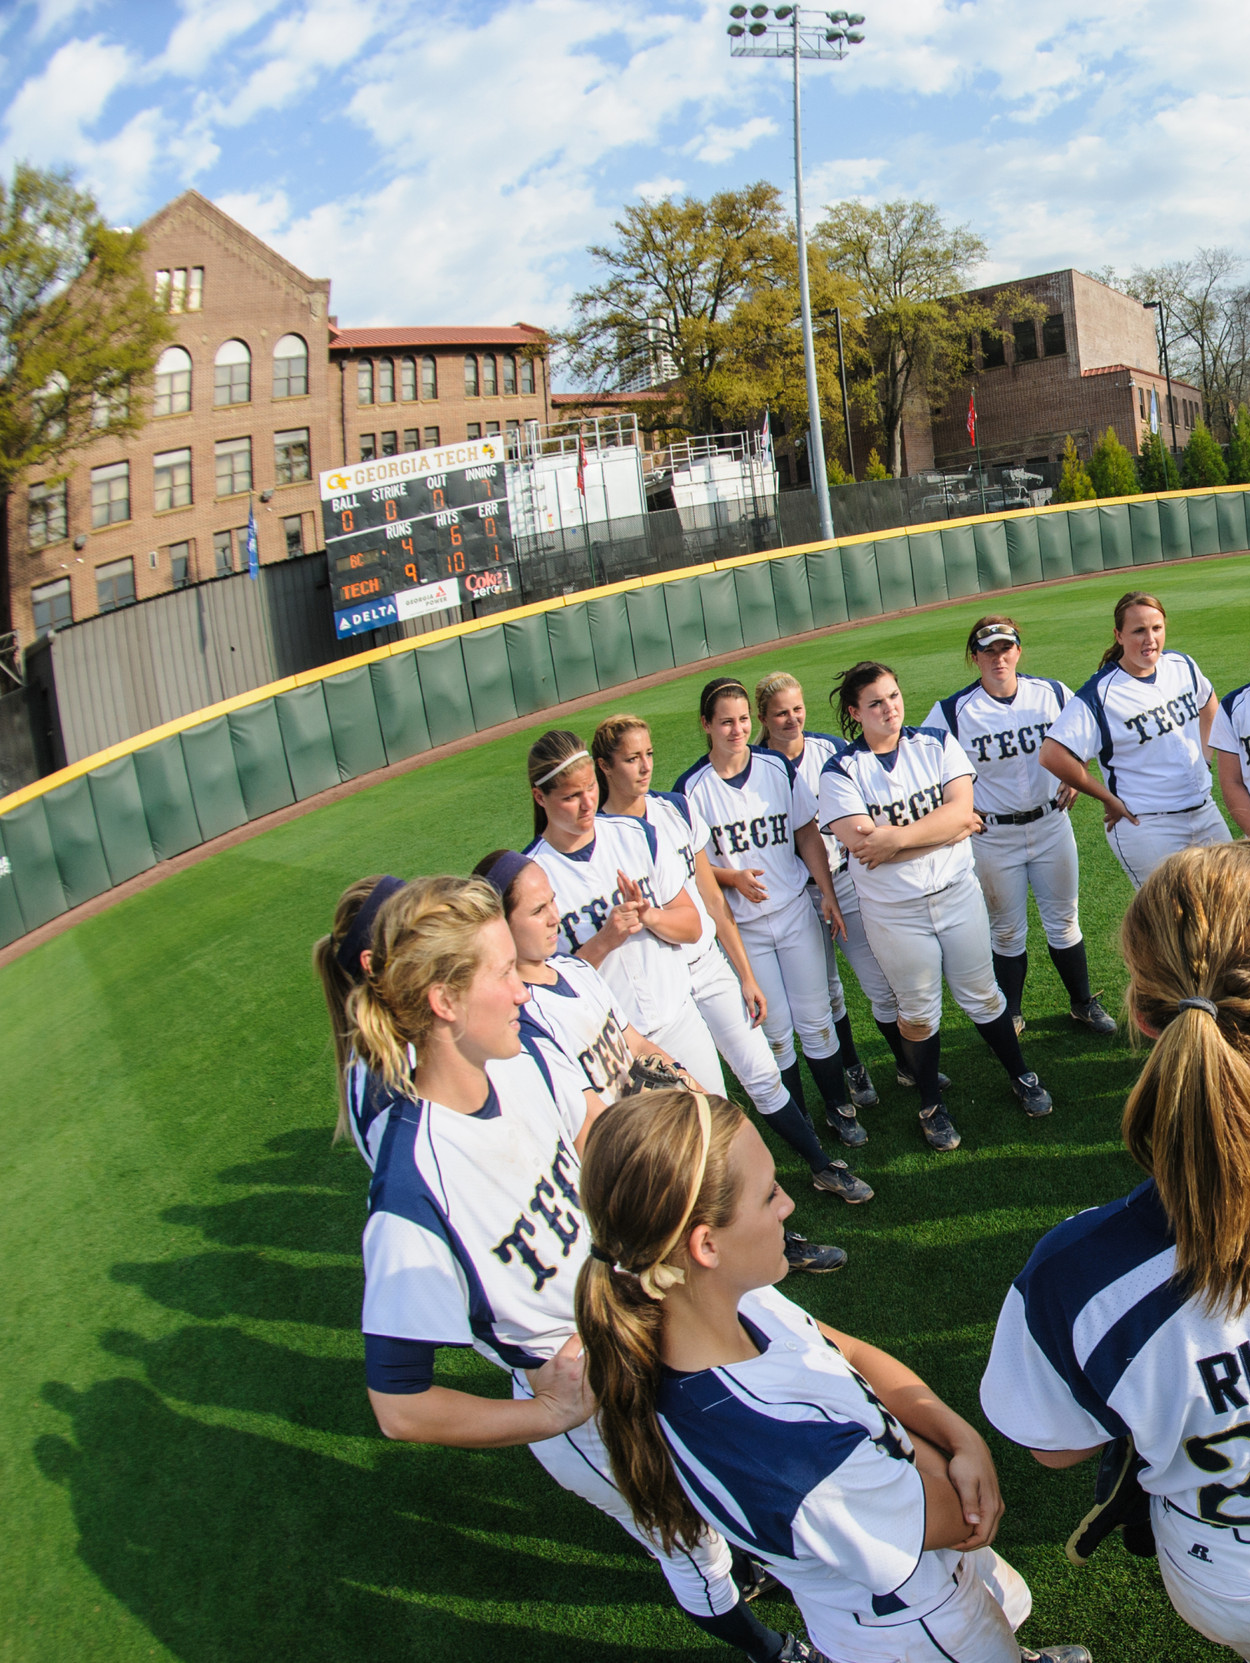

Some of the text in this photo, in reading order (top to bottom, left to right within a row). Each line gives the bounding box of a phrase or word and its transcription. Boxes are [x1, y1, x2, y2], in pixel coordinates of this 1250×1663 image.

[355, 455, 431, 485] GEORGIA
[433, 446, 479, 467] TECH
[332, 464, 497, 512] BALL STRIKE OUT INNING
[341, 479, 492, 532] 0 0 0 7
[386, 502, 499, 539] RUNS HITS ERR
[401, 538, 414, 555] 4
[450, 525, 462, 546] 6
[485, 517, 497, 537] 0
[342, 544, 500, 600] TECH 9 10 1
[465, 570, 503, 591] Coke
[472, 584, 500, 599] zero
[352, 603, 397, 625] DELTA
[1124, 691, 1200, 745] TECH
[710, 813, 789, 857] TECH
[577, 1007, 630, 1094] TEC
[490, 1135, 583, 1293] TEC
